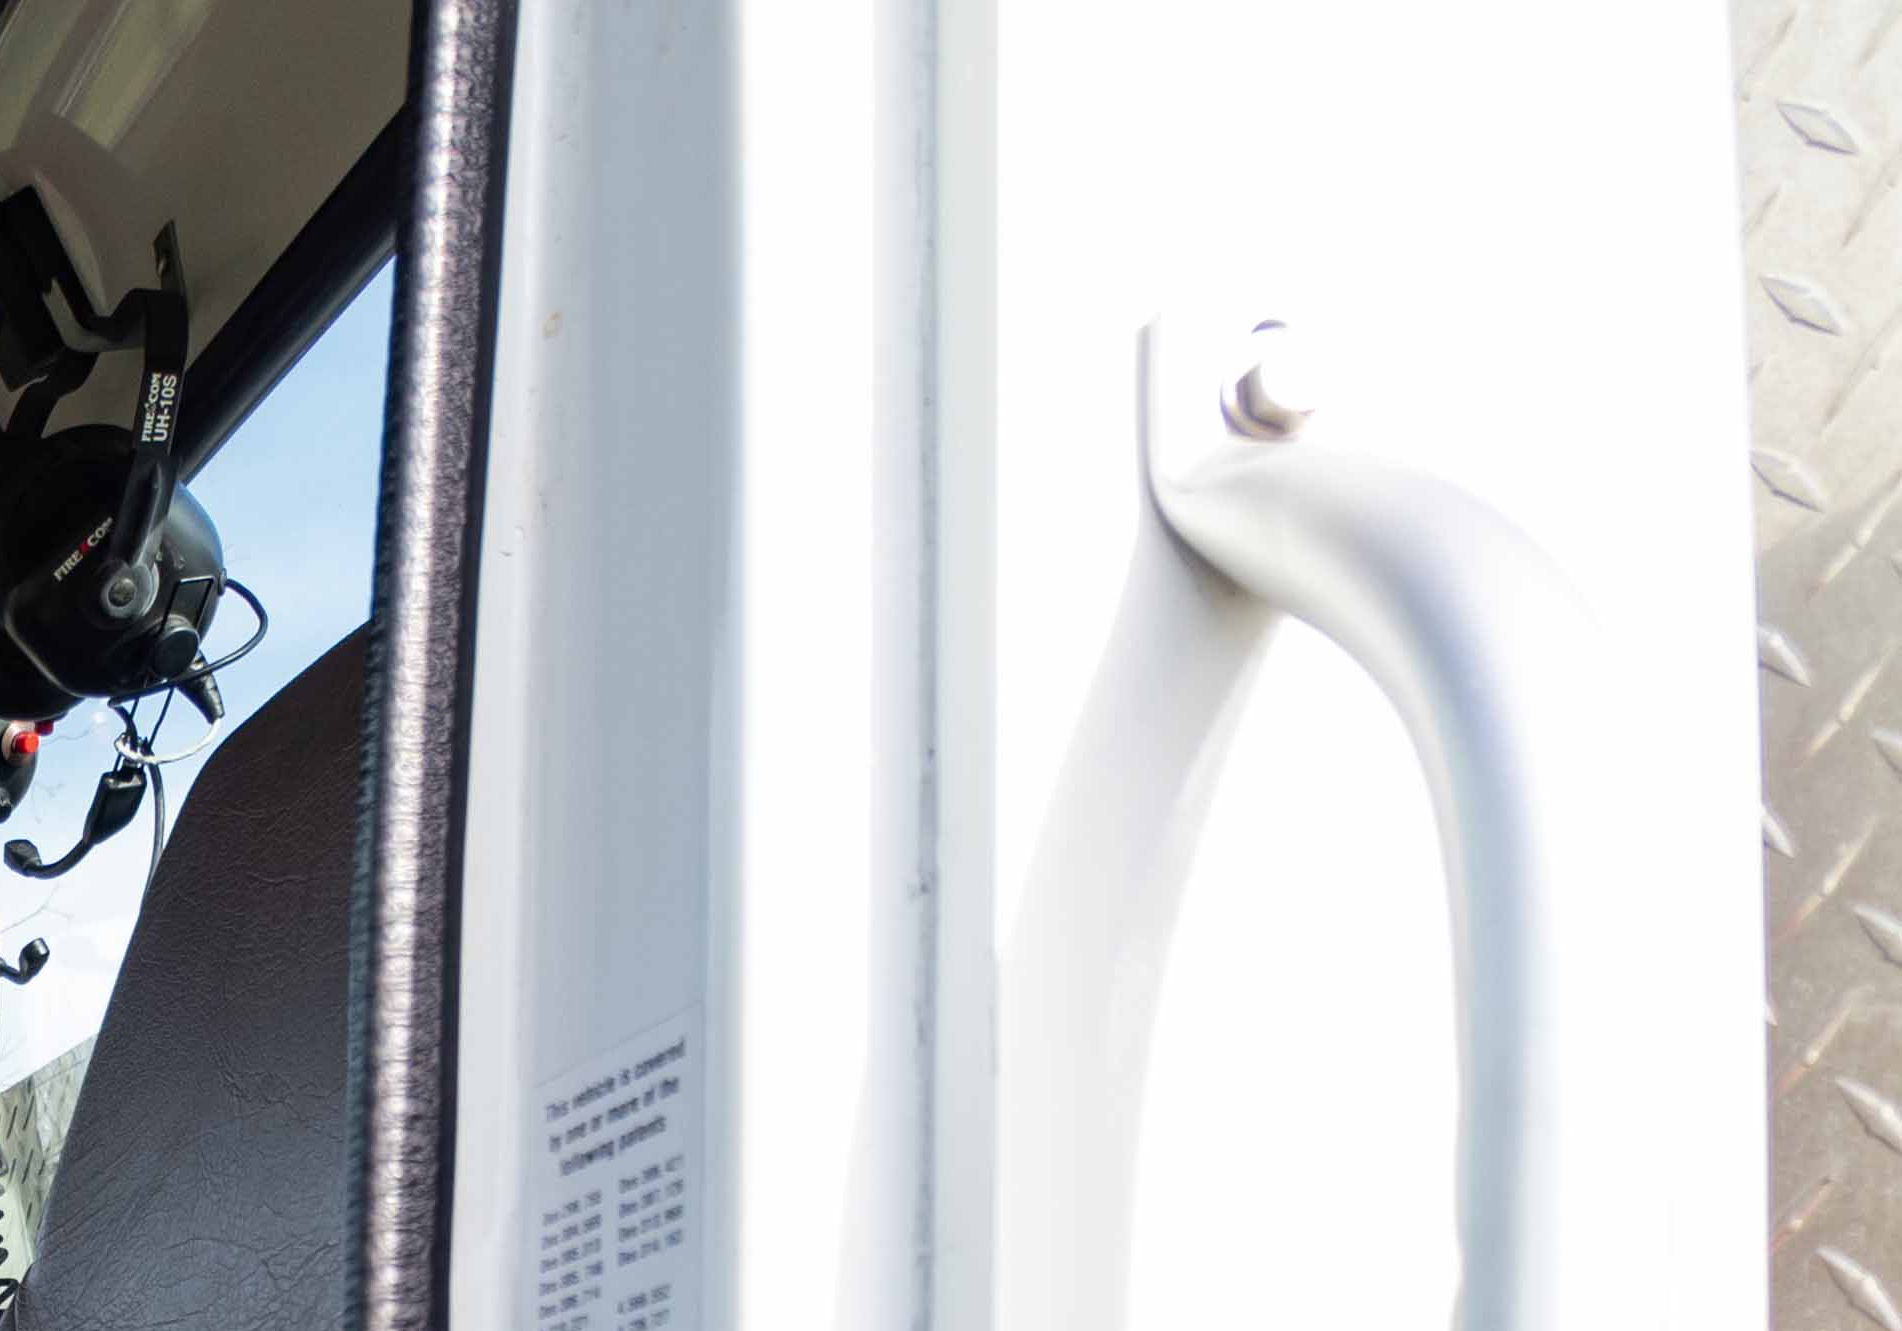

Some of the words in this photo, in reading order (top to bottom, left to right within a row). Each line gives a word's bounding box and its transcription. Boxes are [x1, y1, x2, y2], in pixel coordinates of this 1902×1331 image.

[153, 374, 178, 443] UH-10S
[635, 1040, 685, 1077] covered
[607, 1096, 639, 1124] more
